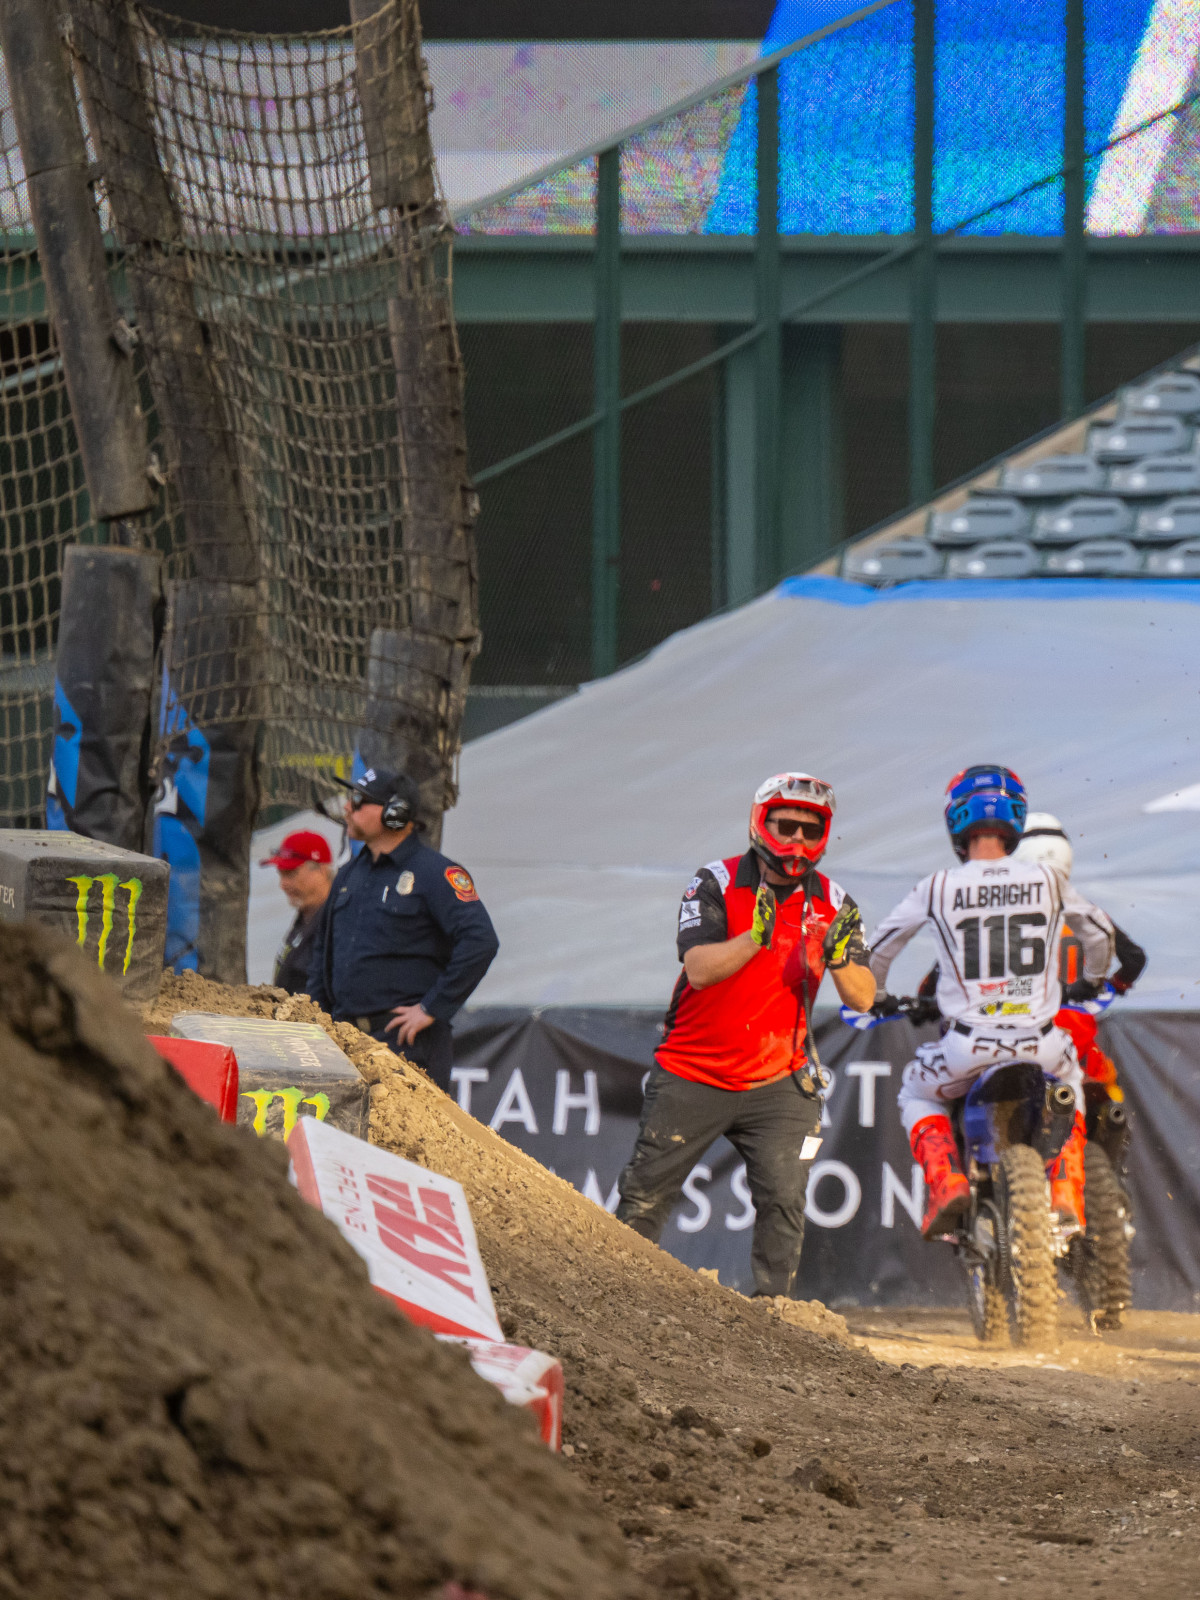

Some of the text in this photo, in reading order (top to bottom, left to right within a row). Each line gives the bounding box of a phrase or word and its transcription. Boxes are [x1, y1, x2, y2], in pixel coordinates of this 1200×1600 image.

[953, 882, 1044, 911] ALBRIGHT
[955, 911, 1047, 980] 116
[450, 1066, 600, 1136] TAH
[365, 1172, 478, 1303] FLY
